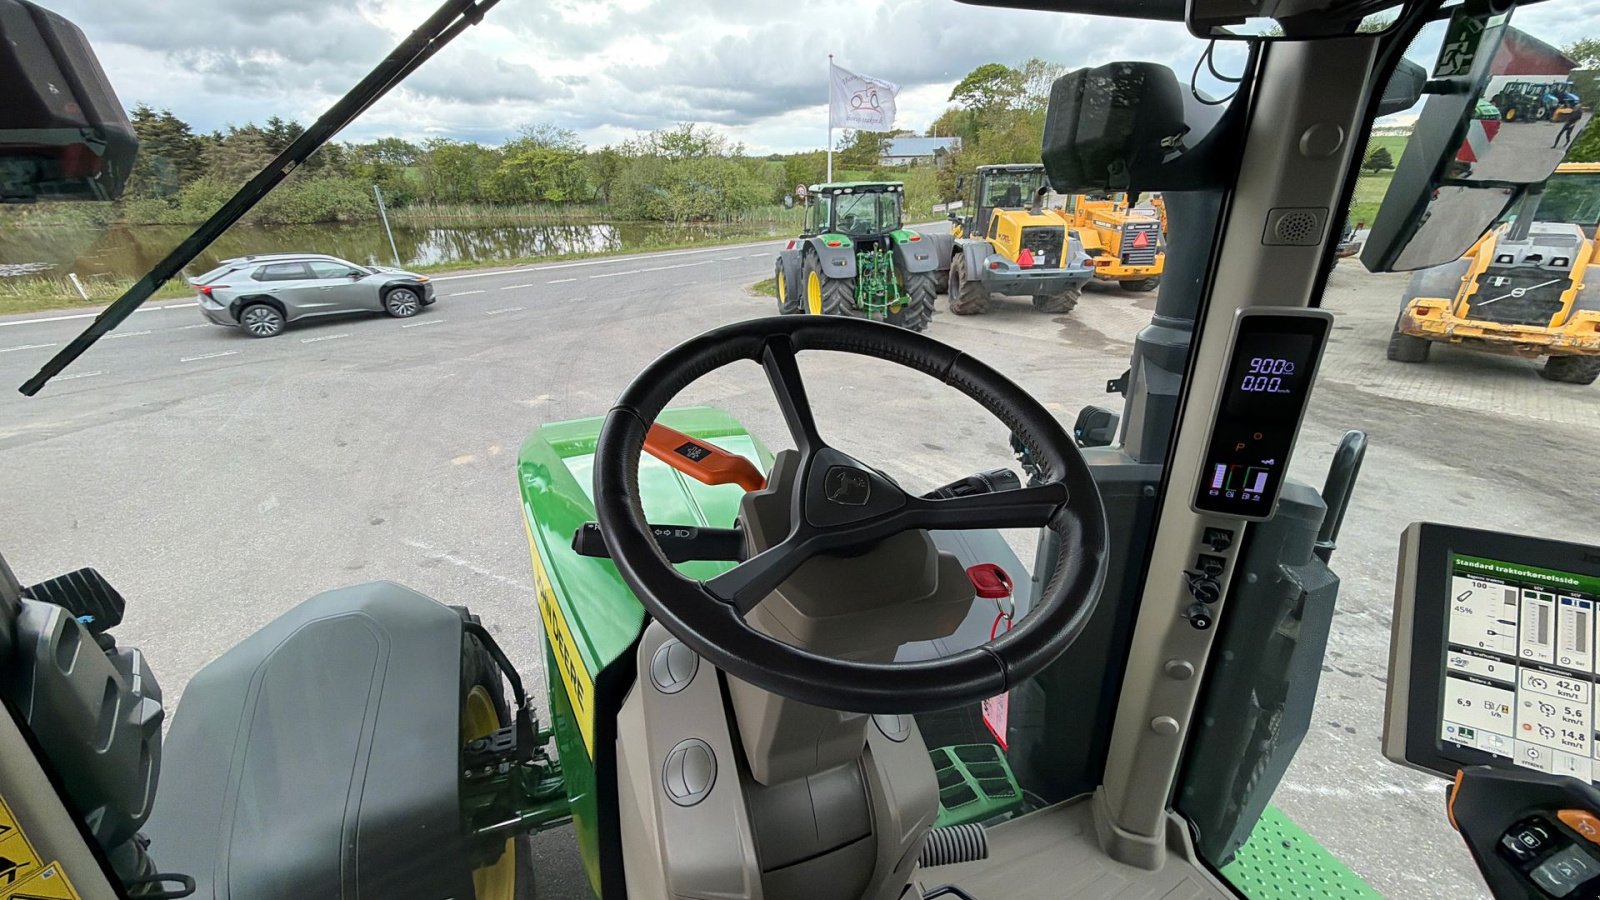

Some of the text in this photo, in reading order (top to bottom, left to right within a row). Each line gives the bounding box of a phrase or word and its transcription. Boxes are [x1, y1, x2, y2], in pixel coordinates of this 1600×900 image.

[1249, 358, 1286, 374] 900
[1235, 443, 1246, 452] P
[1456, 559, 1494, 571] Standard
[1472, 581, 1487, 589] 100
[1454, 606, 1473, 615] 45%
[552, 607, 585, 713] DEERE
[1488, 664, 1494, 672] 0
